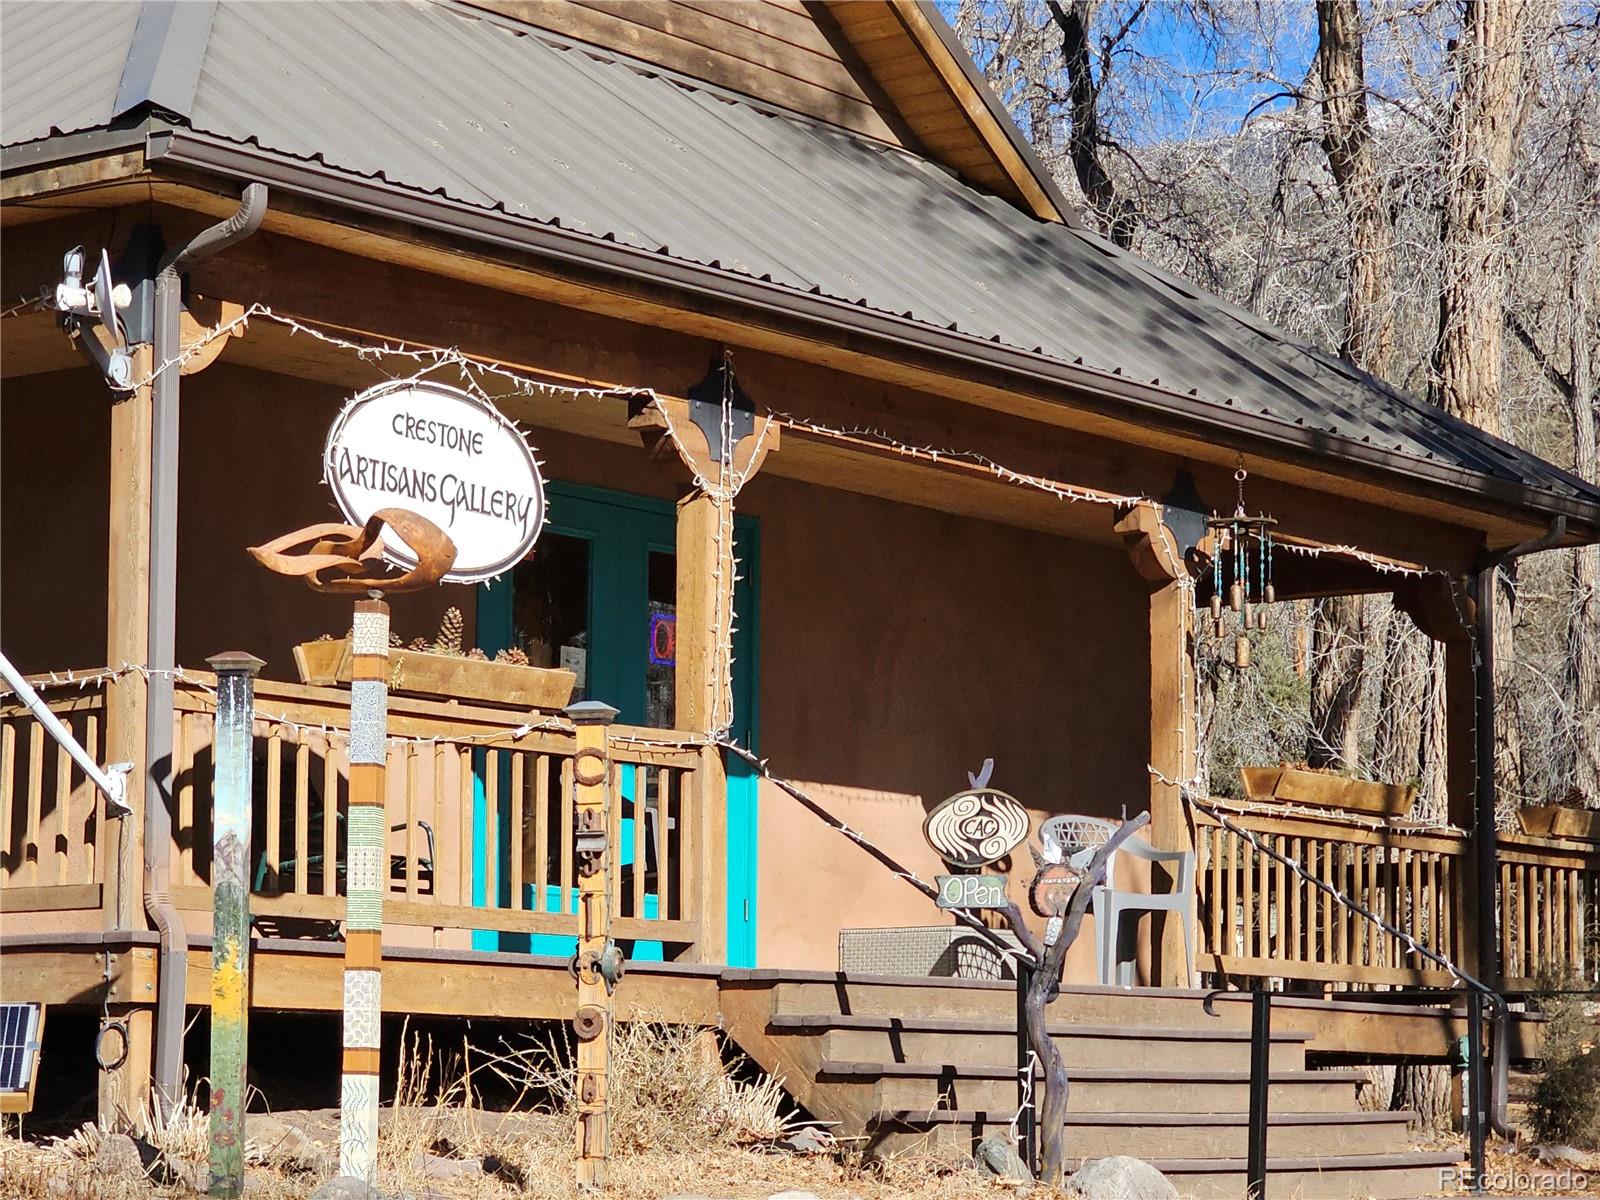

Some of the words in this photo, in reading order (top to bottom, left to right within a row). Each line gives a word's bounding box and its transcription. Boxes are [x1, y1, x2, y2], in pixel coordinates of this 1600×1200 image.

[392, 412, 484, 457] CRESTONE
[339, 446, 437, 503] ARTISANS
[440, 474, 533, 542] GALLERY
[964, 819, 997, 838] CAG
